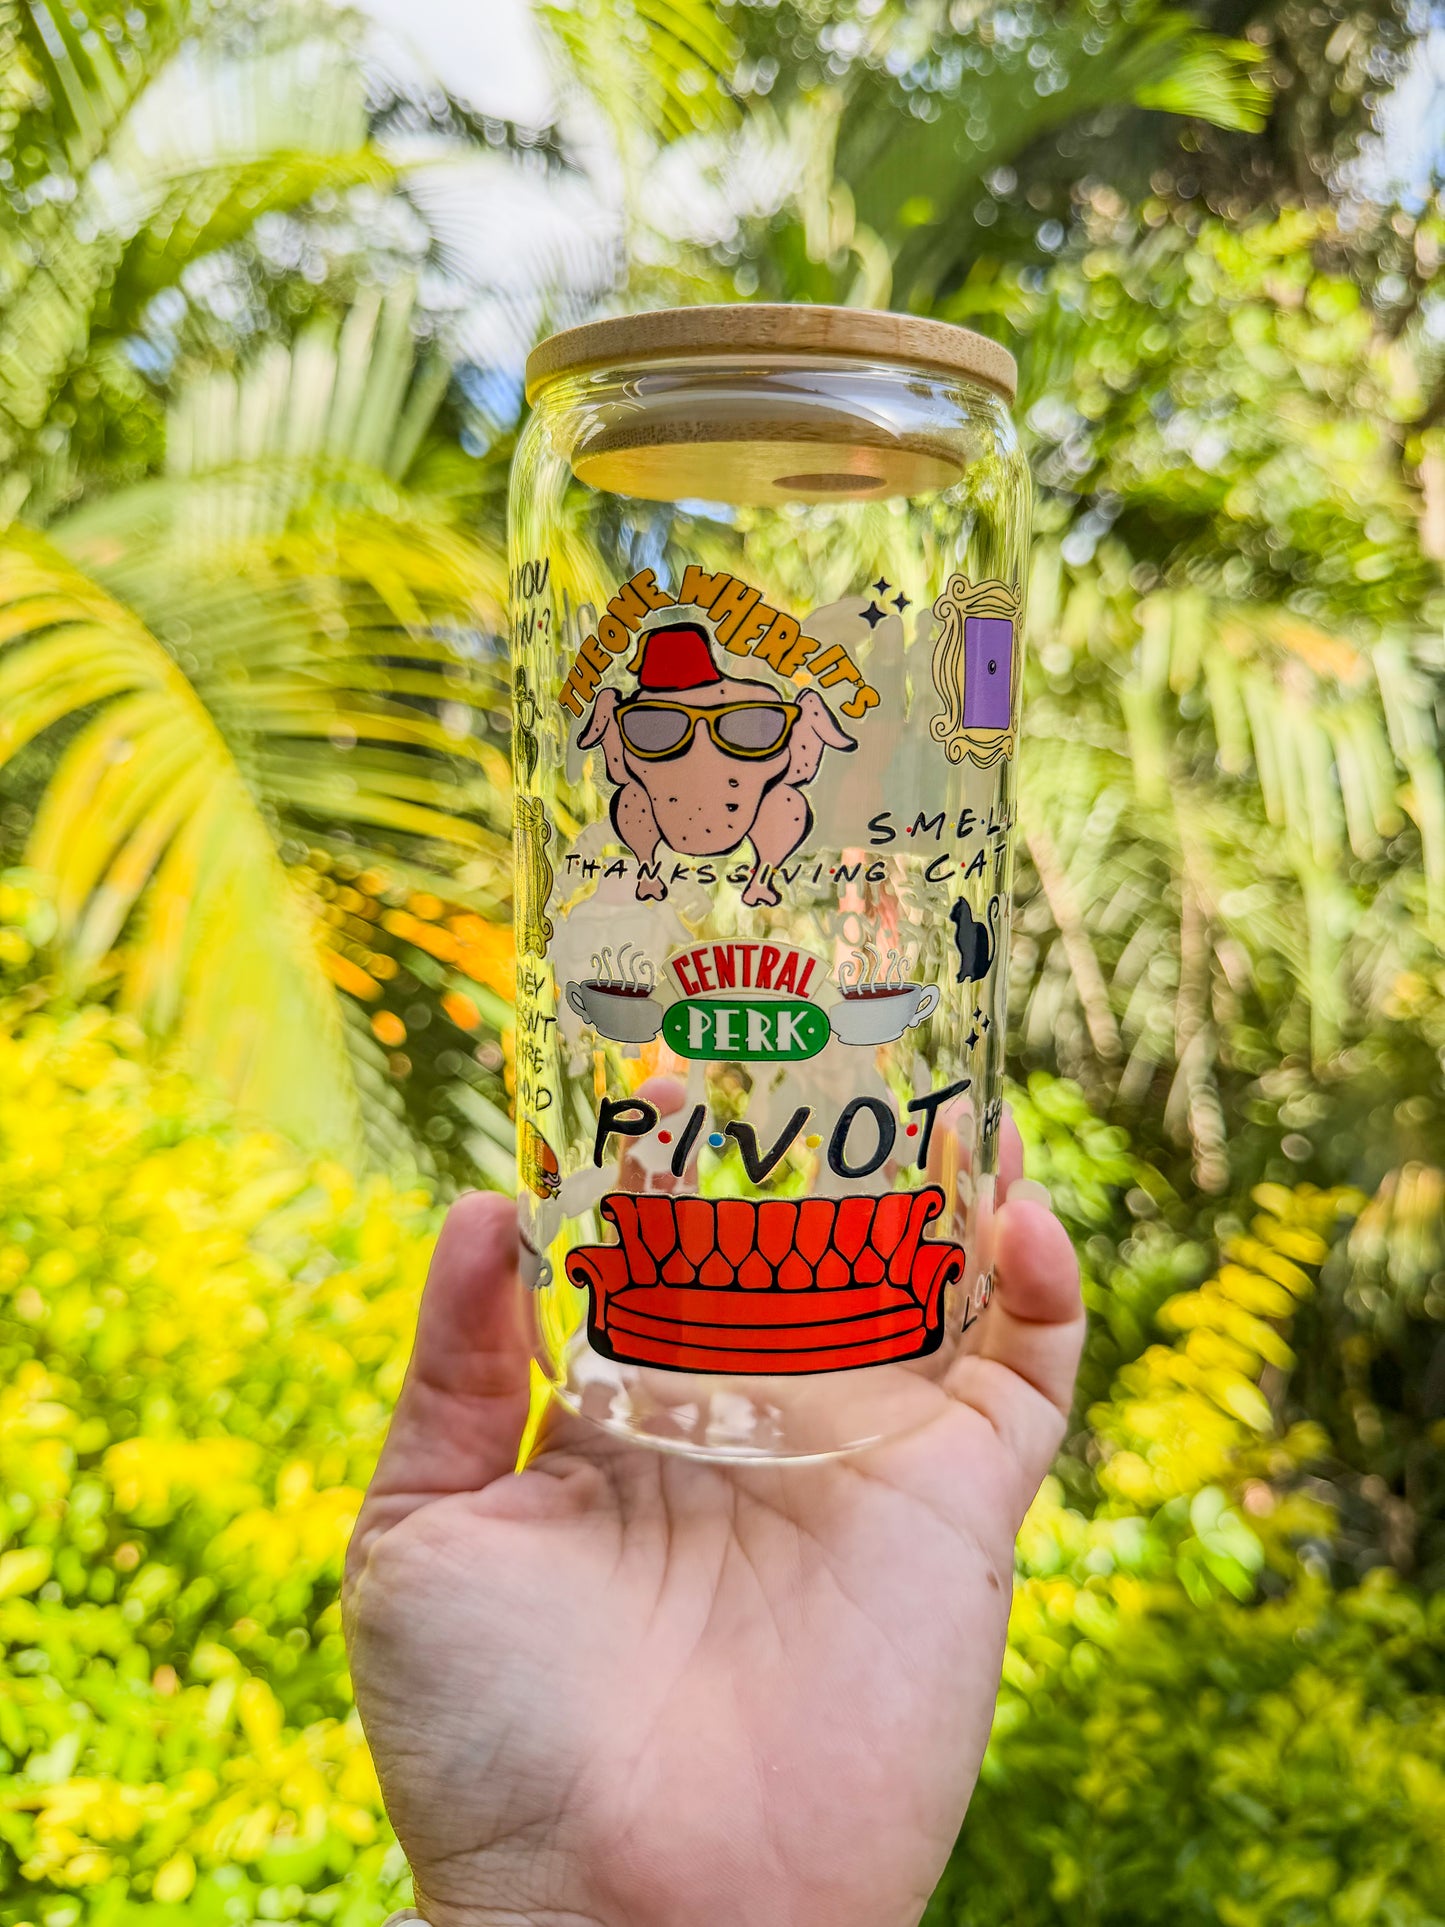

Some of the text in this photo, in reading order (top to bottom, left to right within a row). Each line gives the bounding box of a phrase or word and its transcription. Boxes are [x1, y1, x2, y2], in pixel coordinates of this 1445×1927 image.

[557, 634, 614, 719] THE
[597, 567, 677, 654] ONE
[677, 564, 822, 678] WHERE
[806, 643, 881, 719] IT'S
[565, 853, 887, 885] THANKSGIVING
[925, 843, 1006, 883] CAT
[671, 943, 817, 1000] CENTRAL
[686, 1005, 809, 1052] PERK
[593, 1078, 972, 1184] PIVOT
